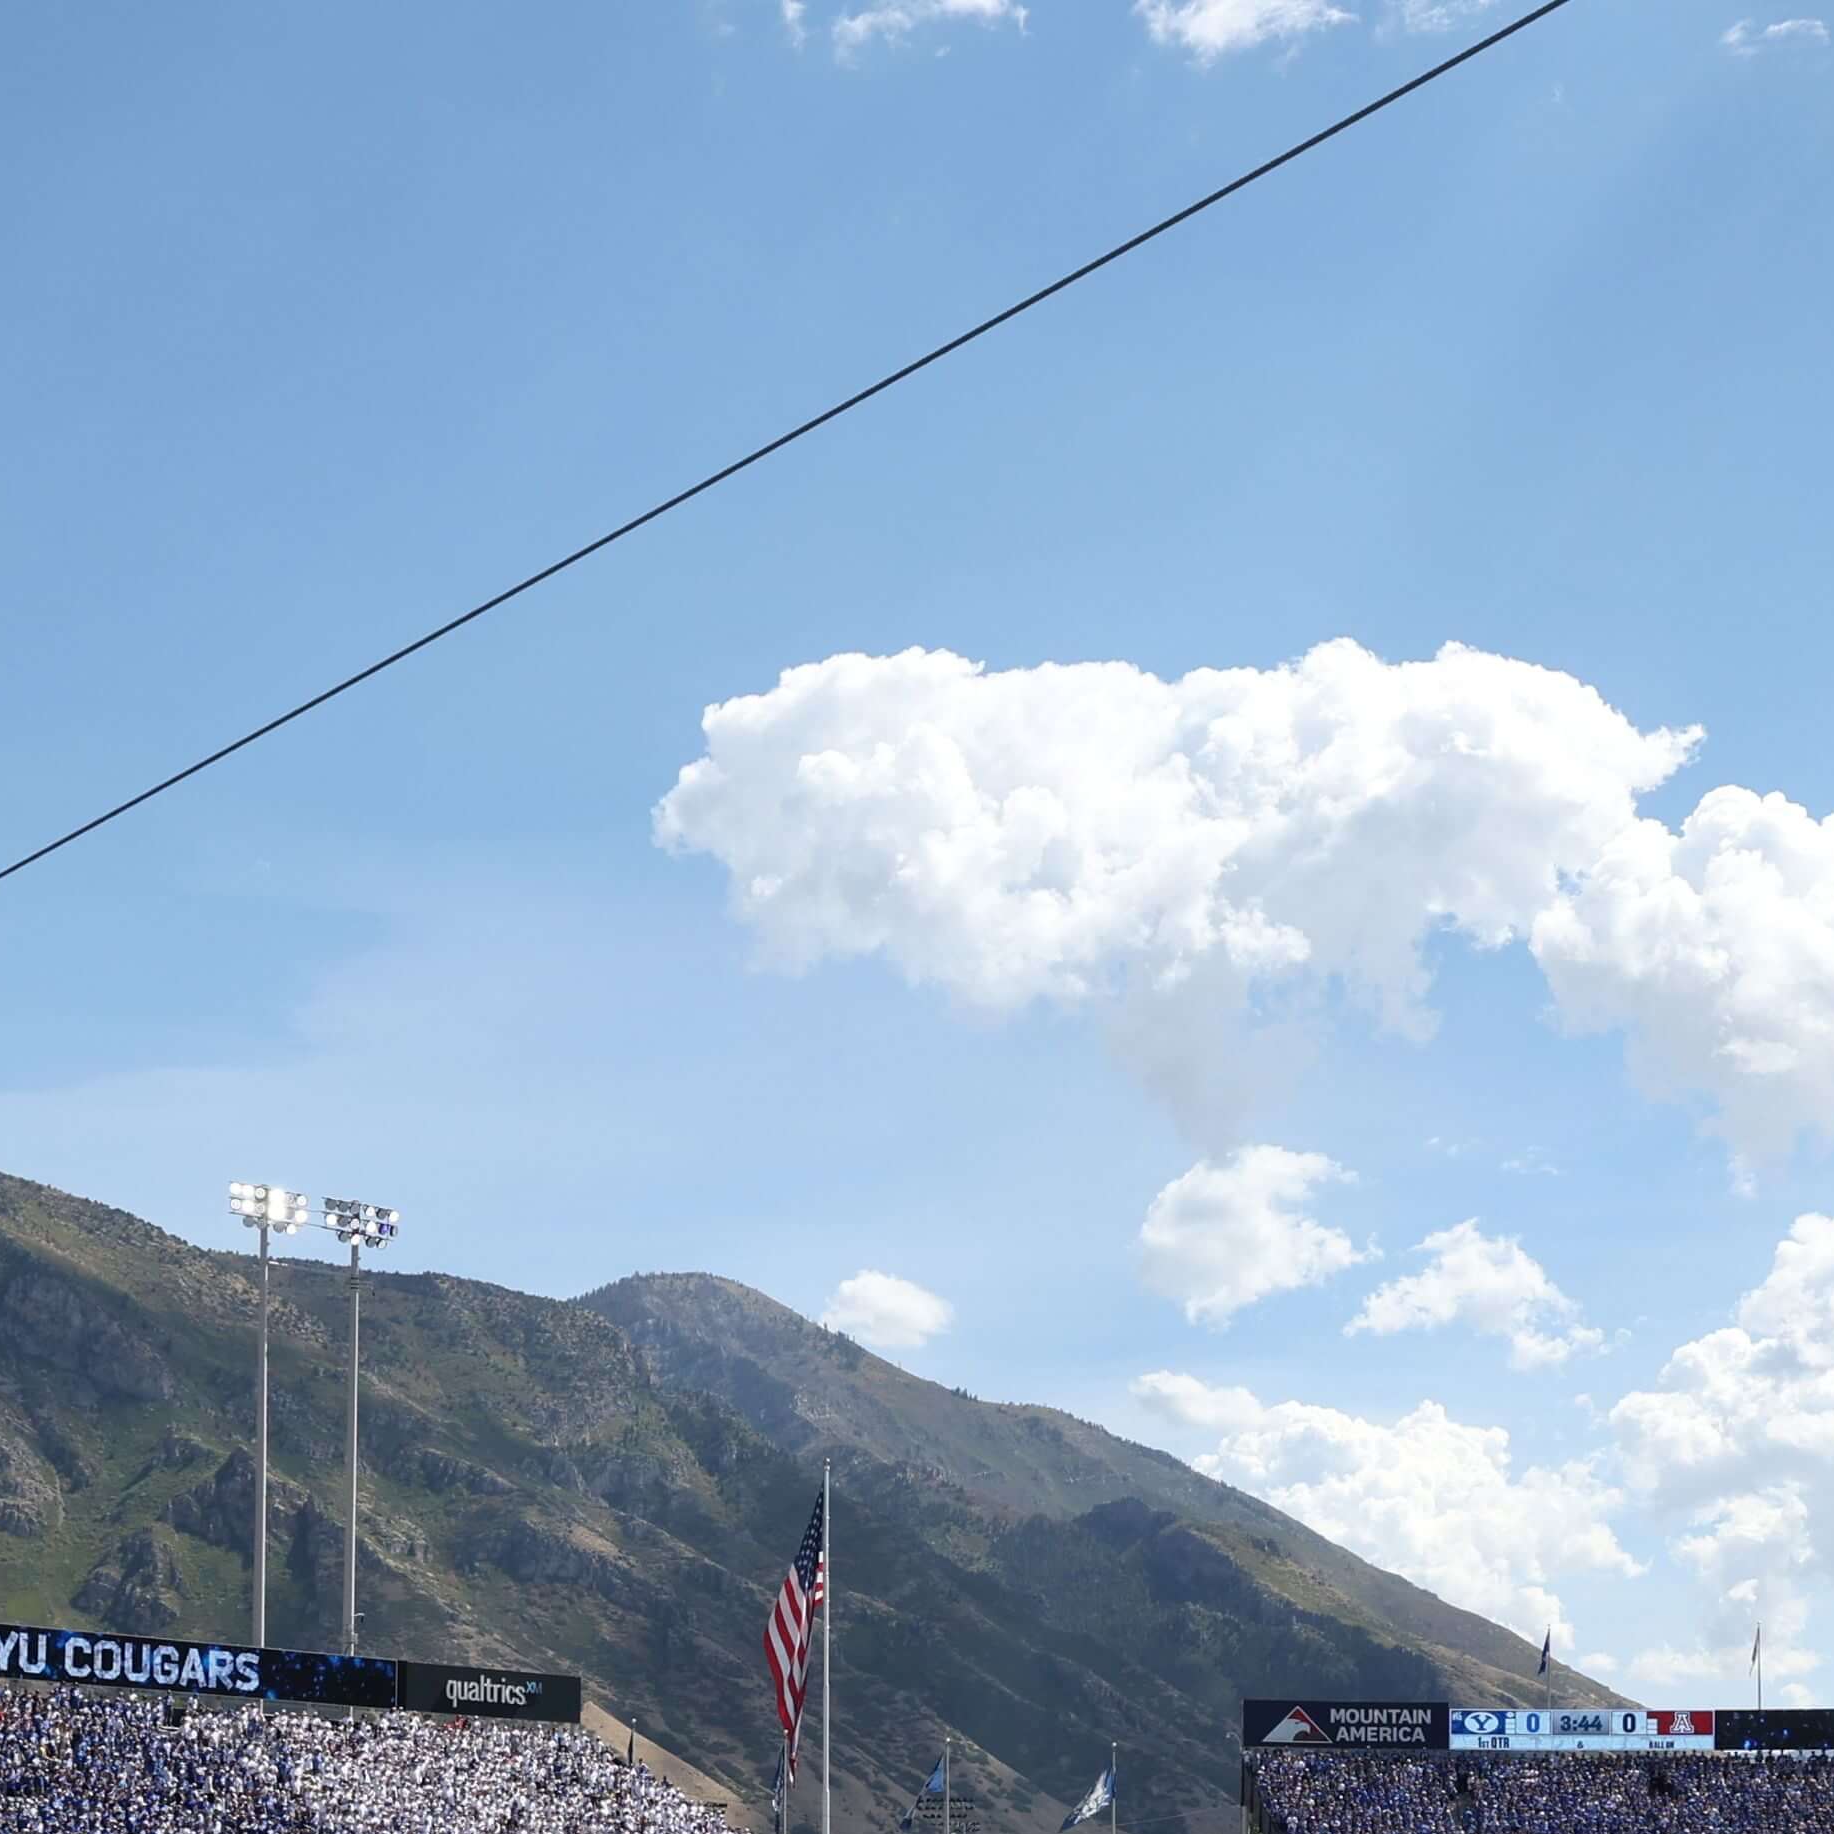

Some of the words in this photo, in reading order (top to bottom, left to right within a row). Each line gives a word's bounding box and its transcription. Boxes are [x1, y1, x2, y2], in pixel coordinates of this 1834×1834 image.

[64, 1636, 261, 1692] COUGARS
[445, 1676, 526, 1705] qualtrics
[1329, 1708, 1432, 1726] MOUNTAIN
[1526, 1713, 1541, 1732] 0
[1560, 1715, 1603, 1732] 3:44
[1622, 1713, 1637, 1732] 0
[1335, 1726, 1426, 1743] AMERICA
[1491, 1735, 1510, 1749] QTR
